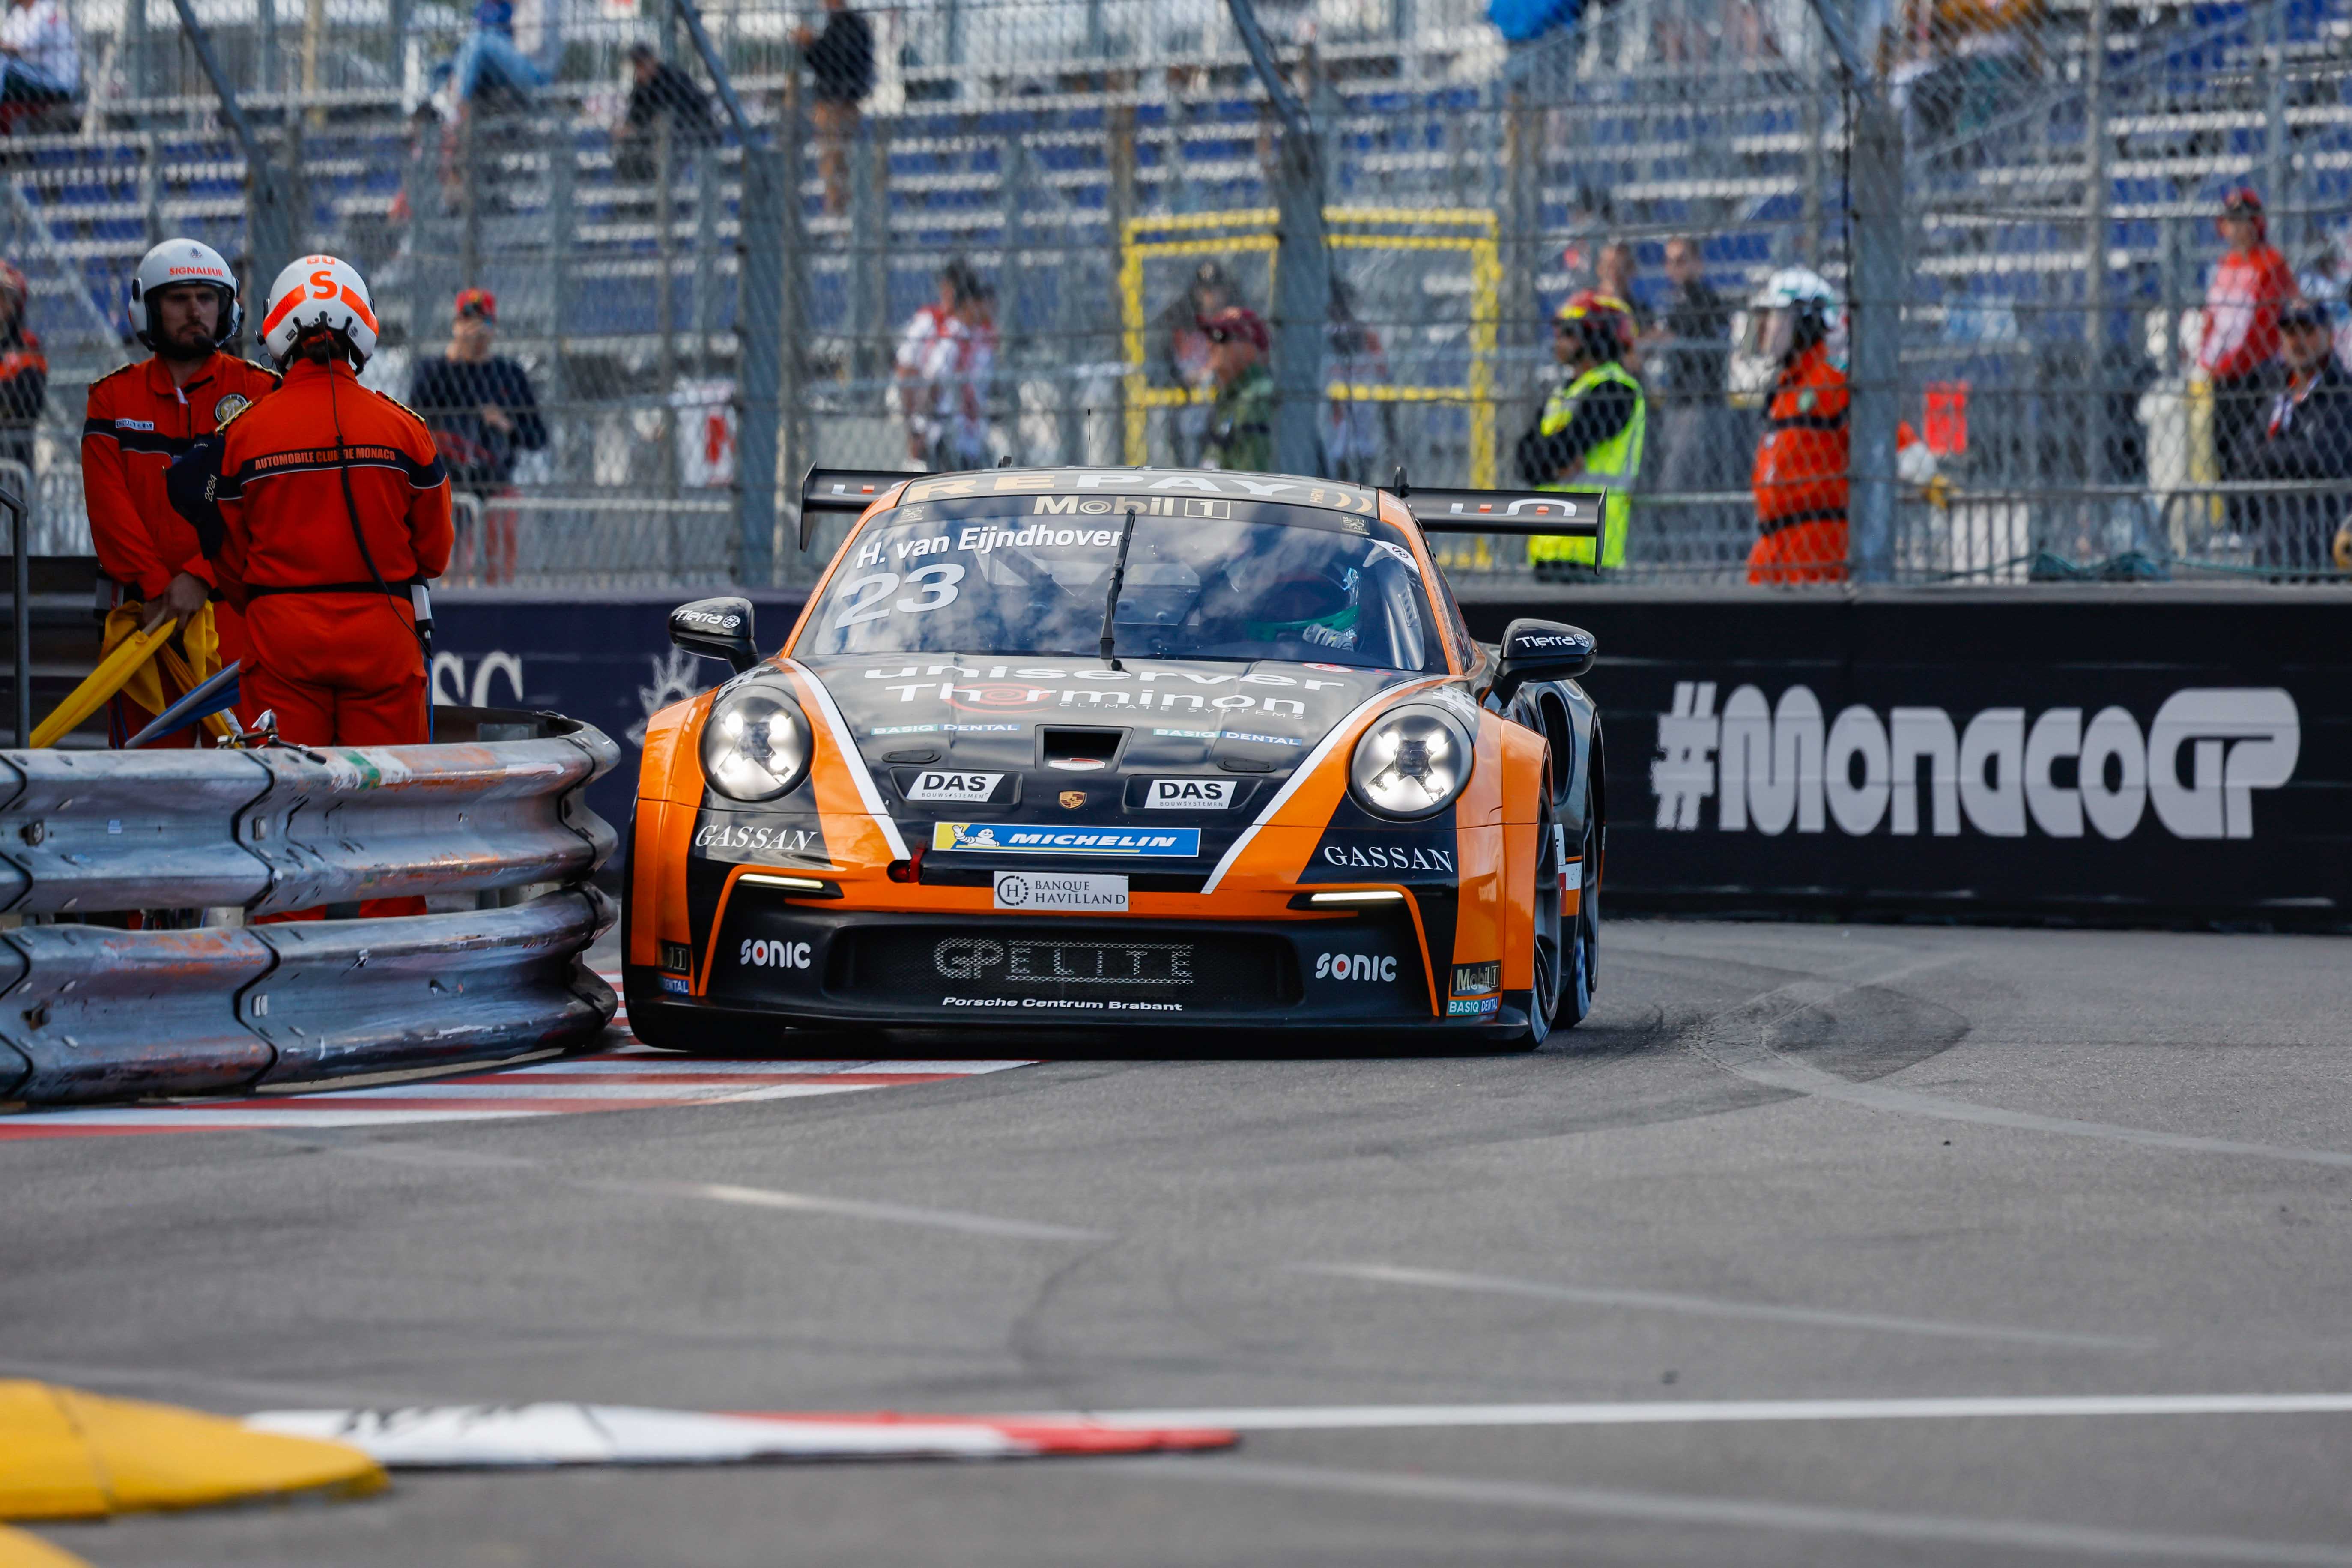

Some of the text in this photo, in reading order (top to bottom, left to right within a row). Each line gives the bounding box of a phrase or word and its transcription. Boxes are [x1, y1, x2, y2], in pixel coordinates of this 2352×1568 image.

[169, 267, 224, 277] SIGNALEUR
[310, 270, 338, 299] S
[255, 452, 314, 470] AUTOMOBILE
[316, 450, 342, 462] CLU
[356, 447, 395, 461] MONACO
[204, 474, 218, 502] 2024
[907, 475, 1298, 503] REPAY
[1033, 496, 1174, 516] Mobil
[856, 542, 886, 569] H.
[896, 536, 949, 559] van
[835, 563, 965, 629] 23
[676, 610, 723, 624] Tierra
[1515, 636, 1576, 648] Tierra
[864, 665, 1344, 690] uniserver
[1059, 702, 1304, 720] CLIMATE SYSTEMS
[872, 726, 935, 734] BASIQ
[1155, 729, 1299, 745] BASIQ DENTAL
[1650, 681, 2301, 840] #MonacoGP
[923, 774, 986, 791] DAS
[1159, 783, 1223, 800] DAS
[695, 825, 818, 851] GASSAN
[1008, 833, 1176, 847] MICHELIN
[1324, 846, 1453, 872] GASSAN
[1035, 880, 1090, 891] BANQUE
[1035, 893, 1126, 905] HAVILLAND
[942, 997, 1182, 1011] Porsche Centrum Brabant
[1449, 998, 1498, 1013] BASIQ DENTAL
